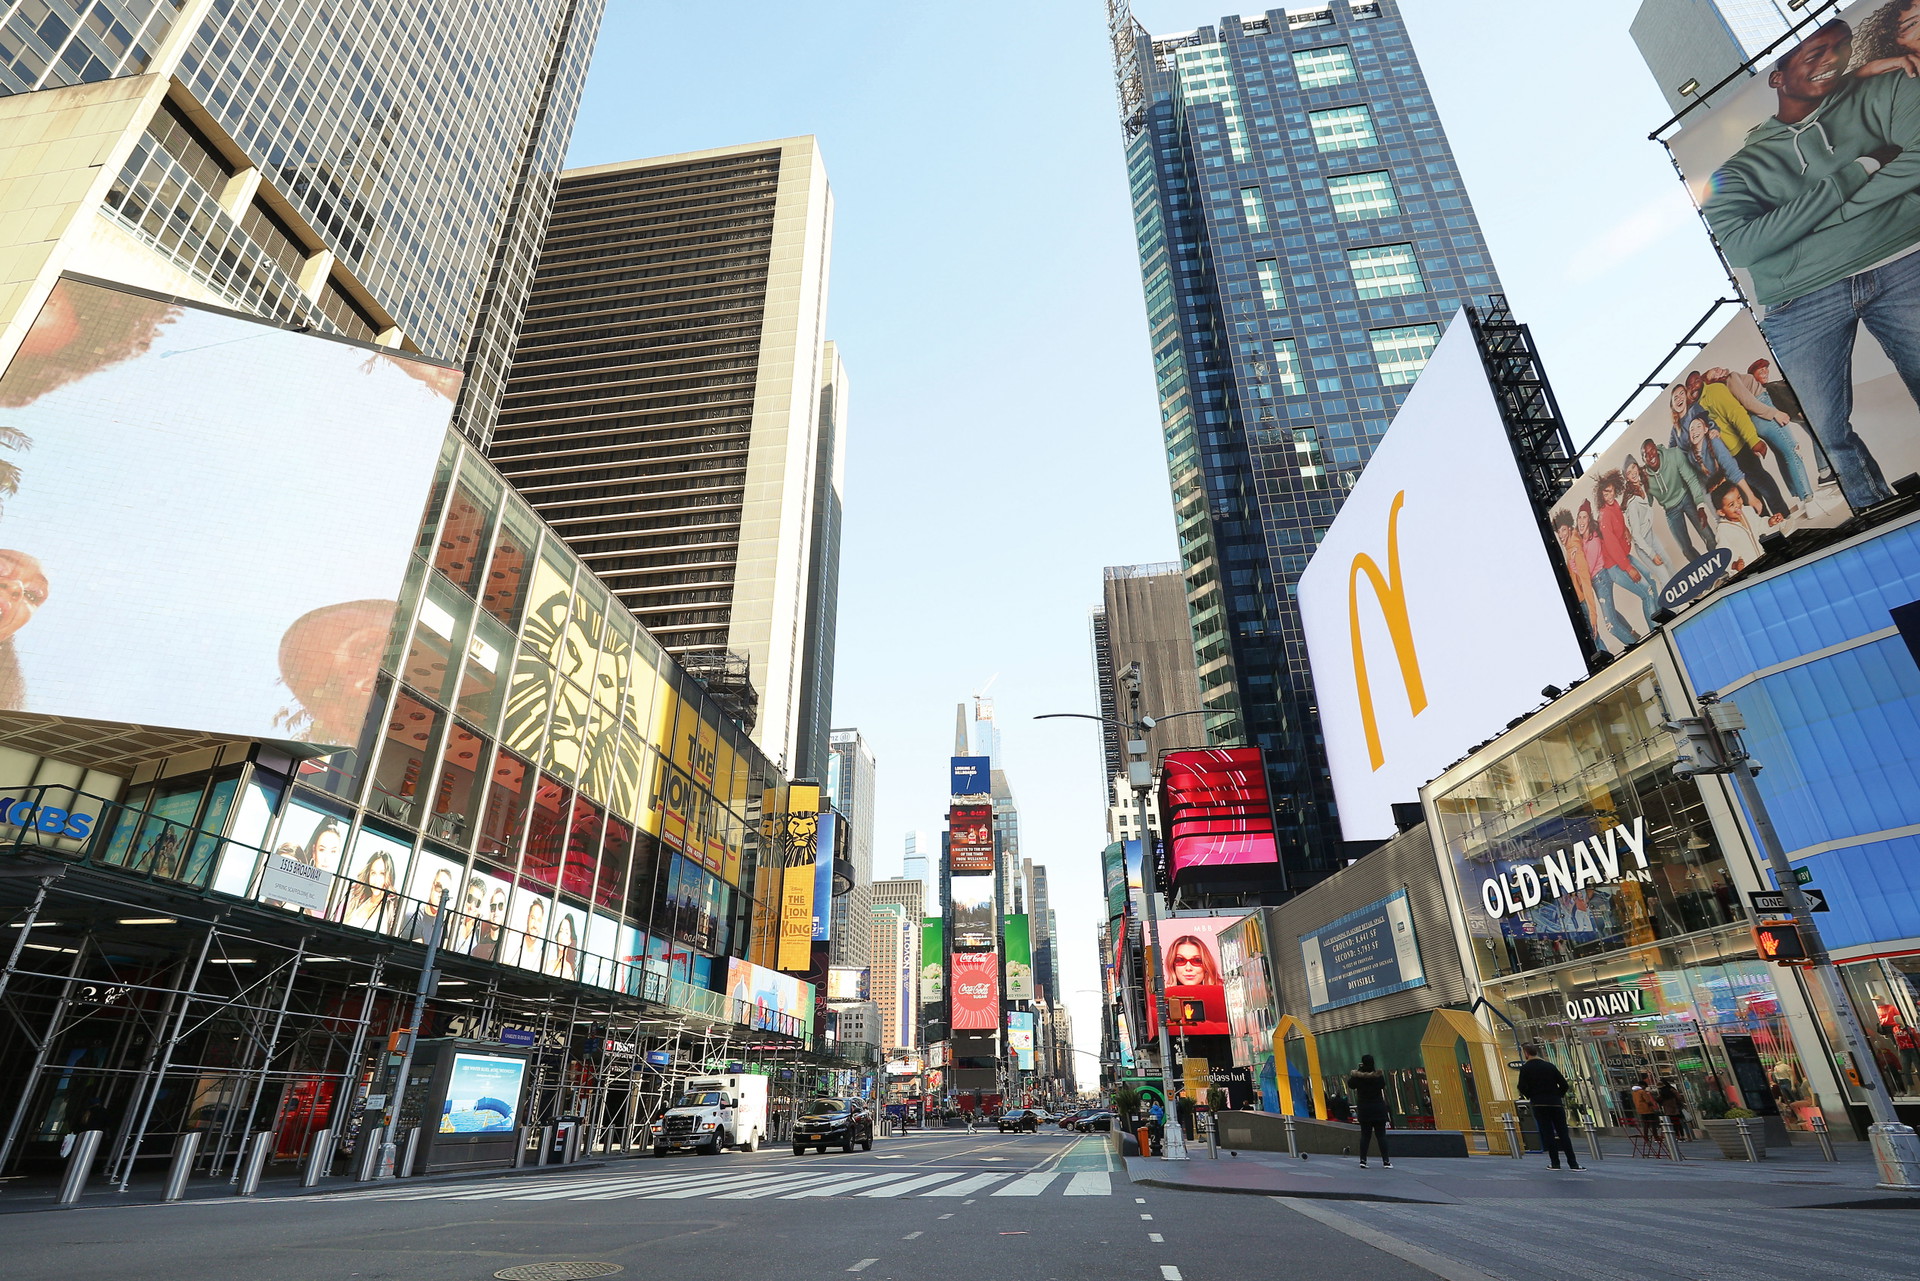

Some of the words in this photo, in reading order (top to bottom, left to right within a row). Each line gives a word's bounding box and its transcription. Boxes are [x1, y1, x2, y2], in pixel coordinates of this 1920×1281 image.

[1664, 577, 1690, 604] OLD
[1687, 553, 1723, 589] NAVY
[688, 732, 714, 779] THE
[280, 858, 294, 872] 1515
[293, 862, 323, 881] BROADWAY
[1482, 864, 1542, 919] OLD
[1543, 816, 1650, 899] NAVY
[788, 895, 805, 903] THE
[1762, 897, 1784, 907] ONE
[784, 905, 808, 919] LION
[781, 920, 810, 938] KING
[1332, 938, 1355, 952] GROUND:
[1370, 928, 1377, 938] SF
[1334, 949, 1357, 964] SECOND:
[1371, 940, 1379, 950] SF
[958, 983, 991, 995] Coca-Cola
[1347, 974, 1376, 990] DIVISIBLE
[1566, 1000, 1597, 1021] OLD
[1597, 989, 1643, 1016] NAVY
[1230, 1072, 1246, 1082] hut
